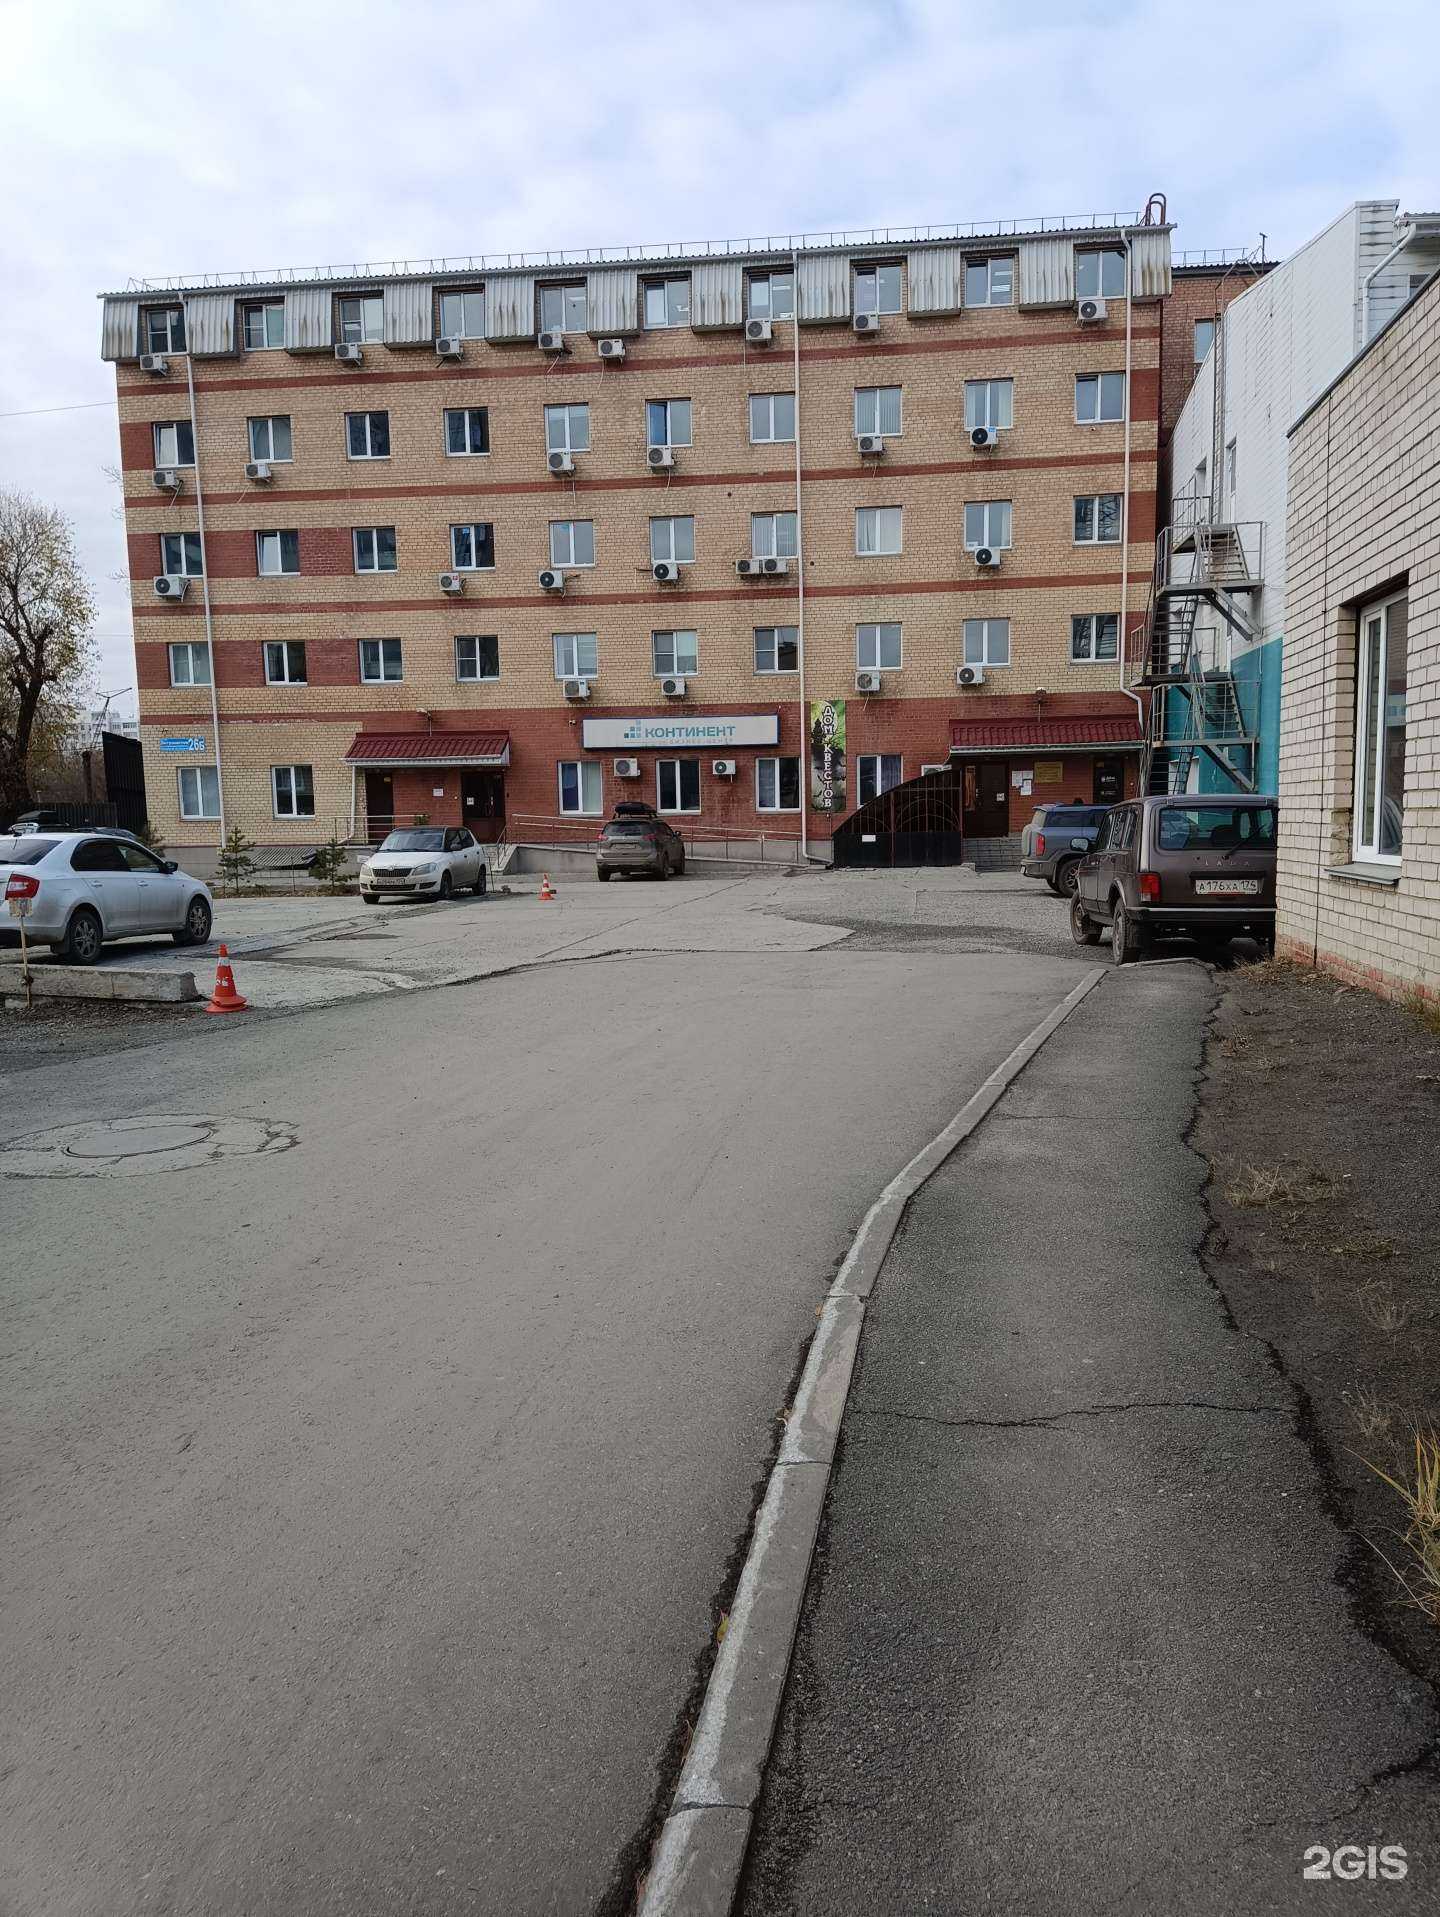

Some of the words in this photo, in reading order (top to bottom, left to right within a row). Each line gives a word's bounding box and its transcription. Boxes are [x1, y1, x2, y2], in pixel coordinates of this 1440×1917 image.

[644, 726, 736, 738] КОНТИНЕНТ
[823, 706, 835, 735] ДОМ
[823, 743, 834, 808] КВЕСТОВ
